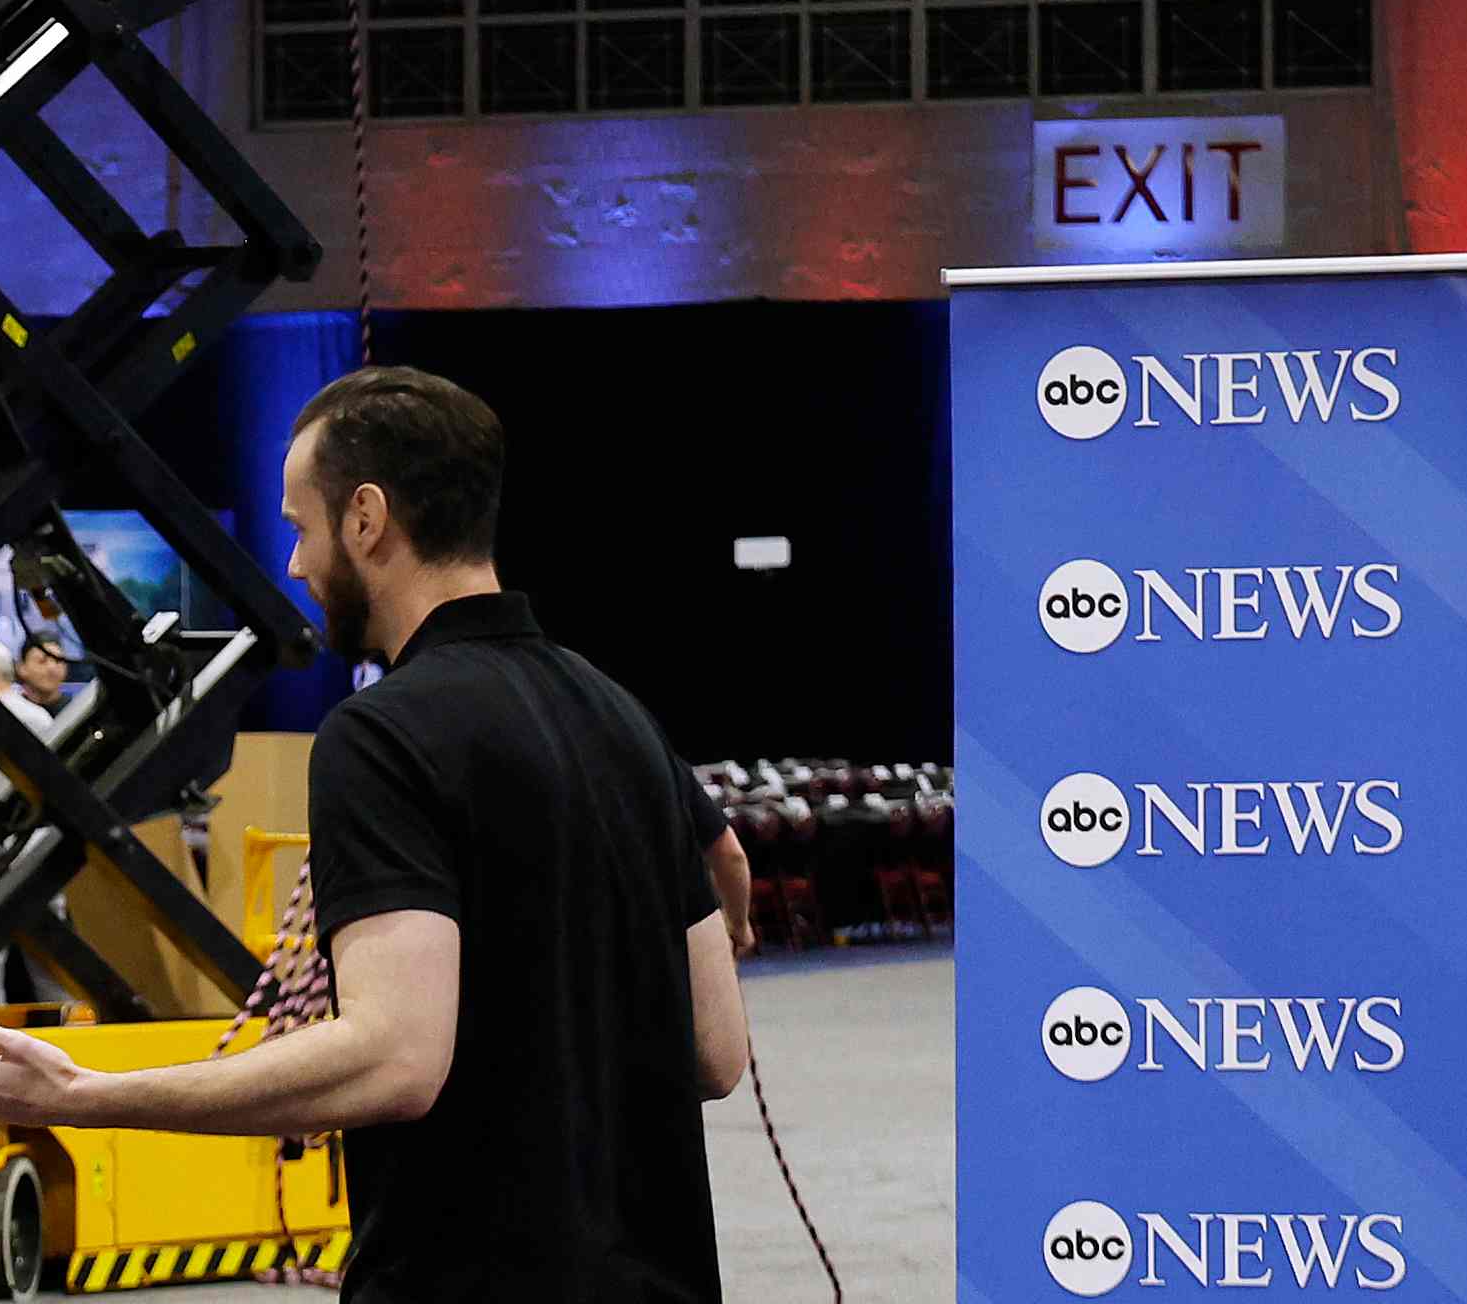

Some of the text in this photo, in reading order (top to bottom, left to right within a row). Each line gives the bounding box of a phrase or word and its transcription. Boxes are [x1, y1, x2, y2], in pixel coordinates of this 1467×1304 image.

[1054, 142, 1262, 225] EXIT
[1044, 347, 1402, 428] abc NEWS
[1046, 563, 1403, 642] abc NEWS
[1047, 779, 1404, 857] abc NEWS
[1049, 995, 1406, 1073] abc NEWS
[1051, 1212, 1407, 1290] abc NEWS
